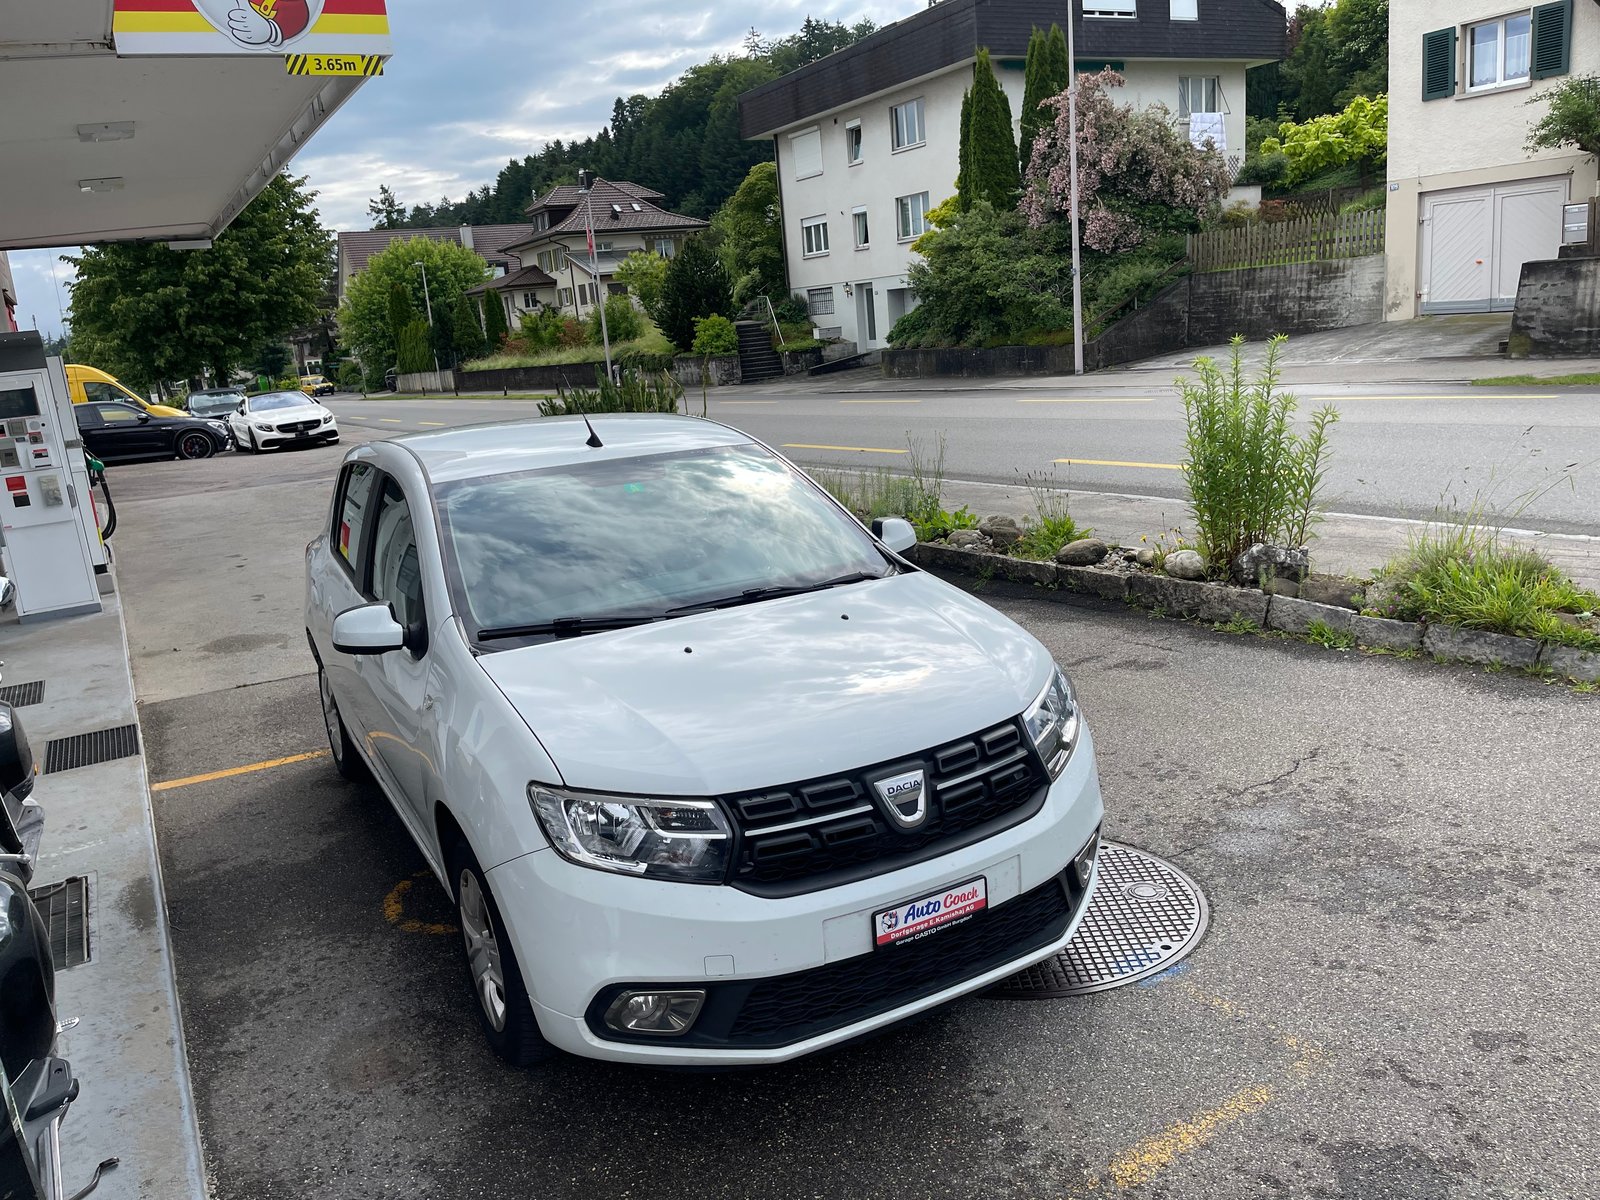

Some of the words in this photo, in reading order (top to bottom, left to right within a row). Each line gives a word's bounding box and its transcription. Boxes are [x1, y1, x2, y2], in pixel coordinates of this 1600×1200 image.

[313, 58, 357, 71] 3.65m
[887, 779, 921, 795] DACIA
[903, 900, 941, 924] Auto
[943, 886, 979, 909] Coach
[890, 922, 929, 939] Dorfgarage
[965, 903, 975, 912] AG
[895, 936, 914, 946] Garage
[914, 927, 937, 940] CASTO
